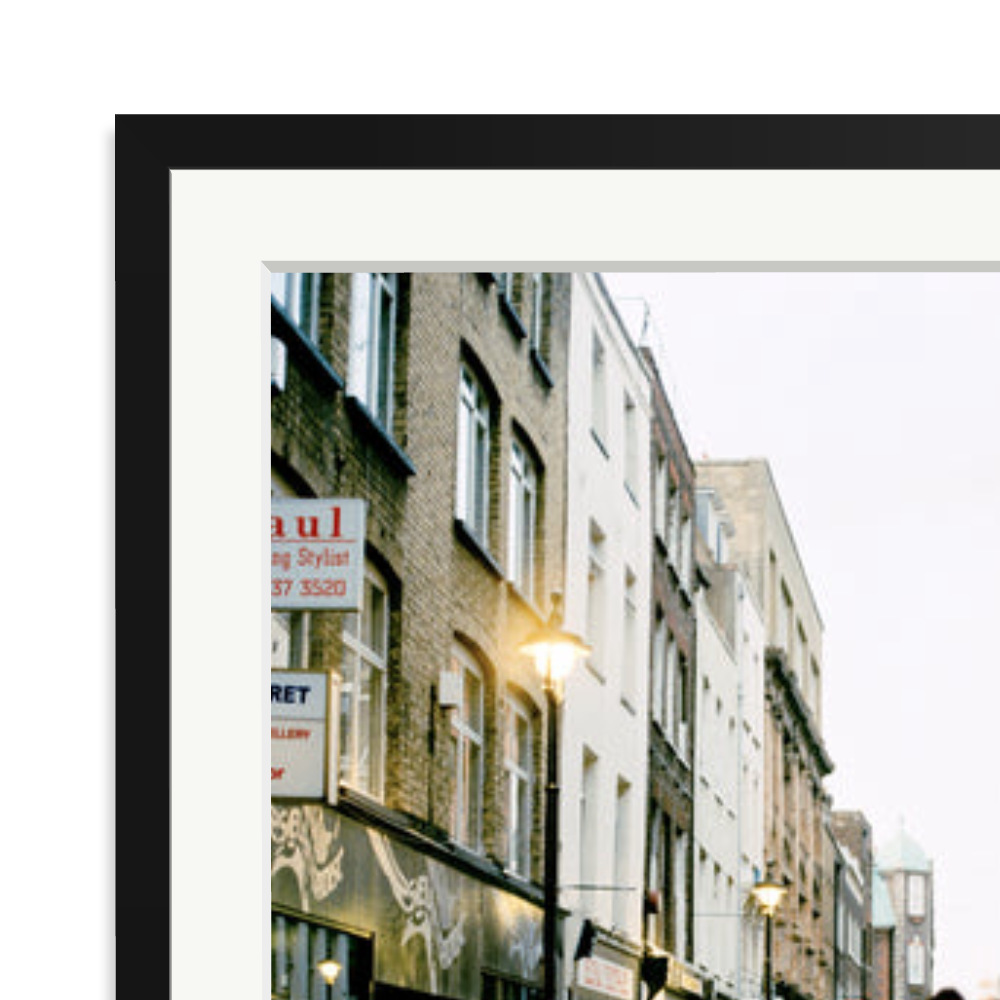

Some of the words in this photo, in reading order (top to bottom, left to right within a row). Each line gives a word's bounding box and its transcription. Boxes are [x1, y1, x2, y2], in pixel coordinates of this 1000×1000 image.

[271, 507, 341, 537] aul
[297, 546, 350, 569] Stylist
[299, 579, 347, 596] 3520
